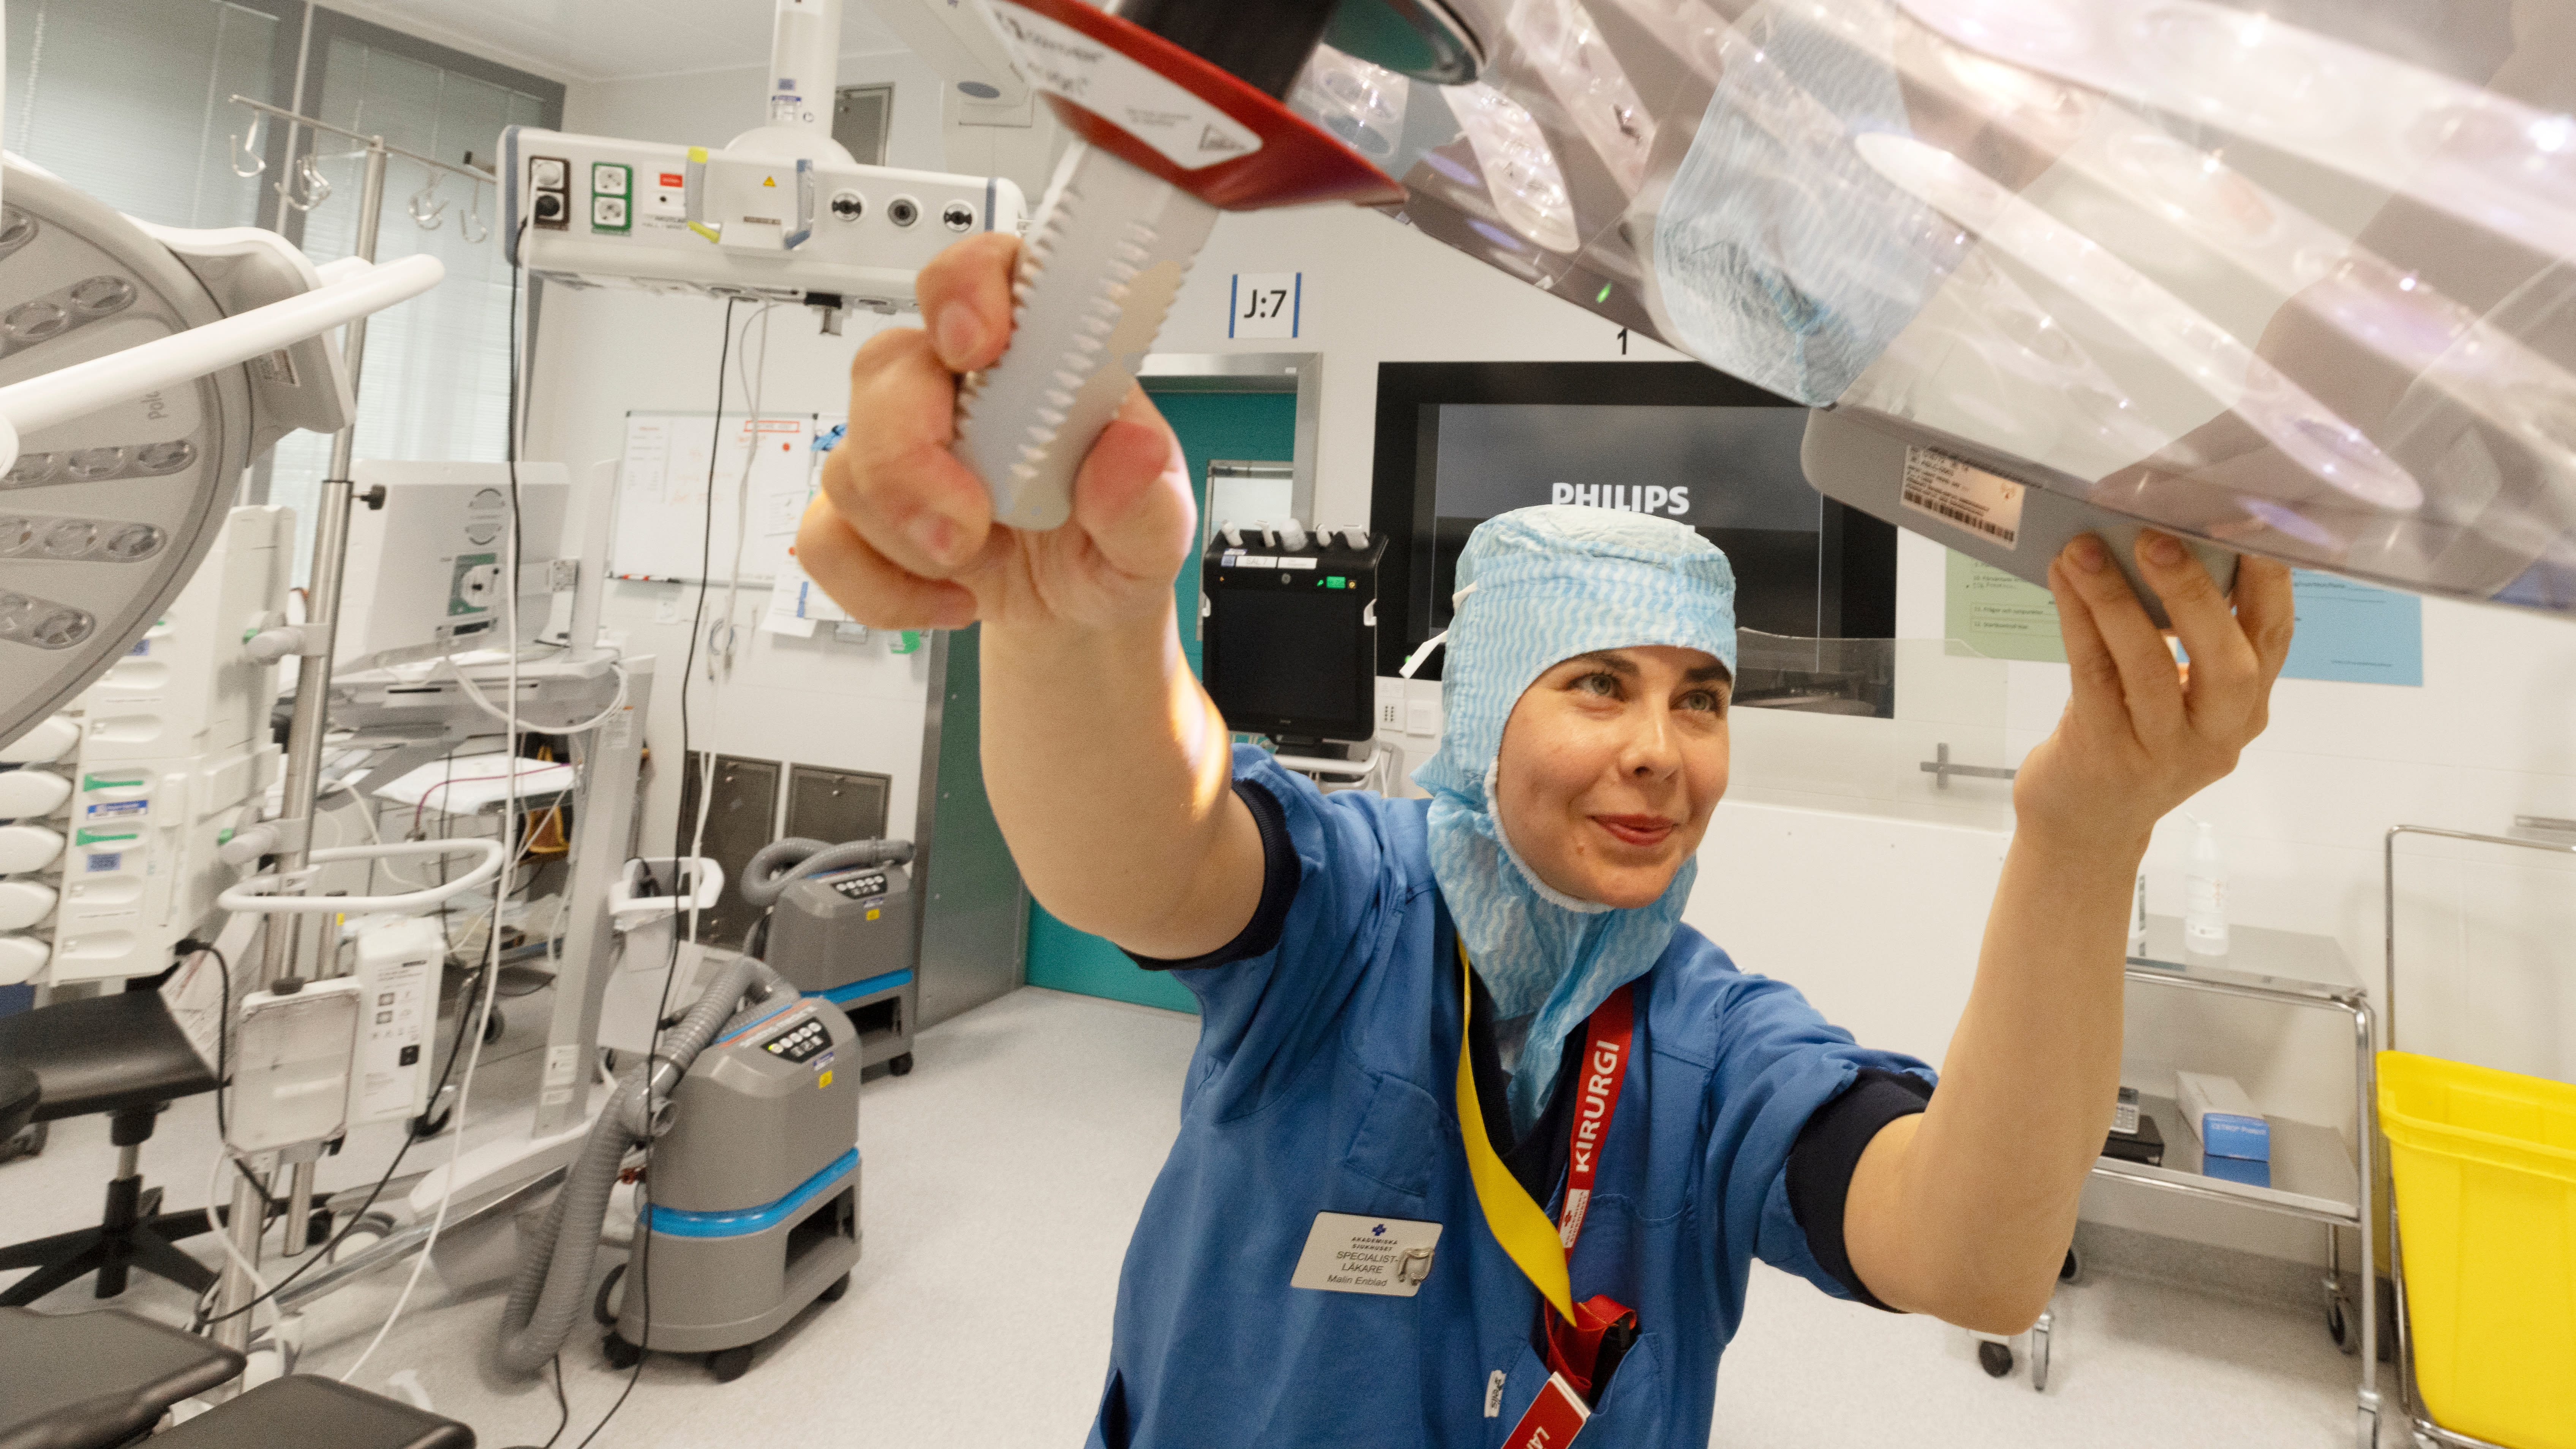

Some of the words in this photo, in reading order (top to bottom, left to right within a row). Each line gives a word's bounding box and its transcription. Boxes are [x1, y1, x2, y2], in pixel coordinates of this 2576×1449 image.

[1244, 289, 1287, 318] J:7
[1617, 327, 1627, 355] 1
[1552, 482, 1690, 515] PHILIPS
[1576, 1040, 1620, 1173] KIRURGI
[1336, 1251, 1399, 1263] SPECIALIST-
[1341, 1262, 1384, 1274] LÄKARE
[1327, 1274, 1353, 1283] Malin
[1354, 1276, 1388, 1286] Enblad
